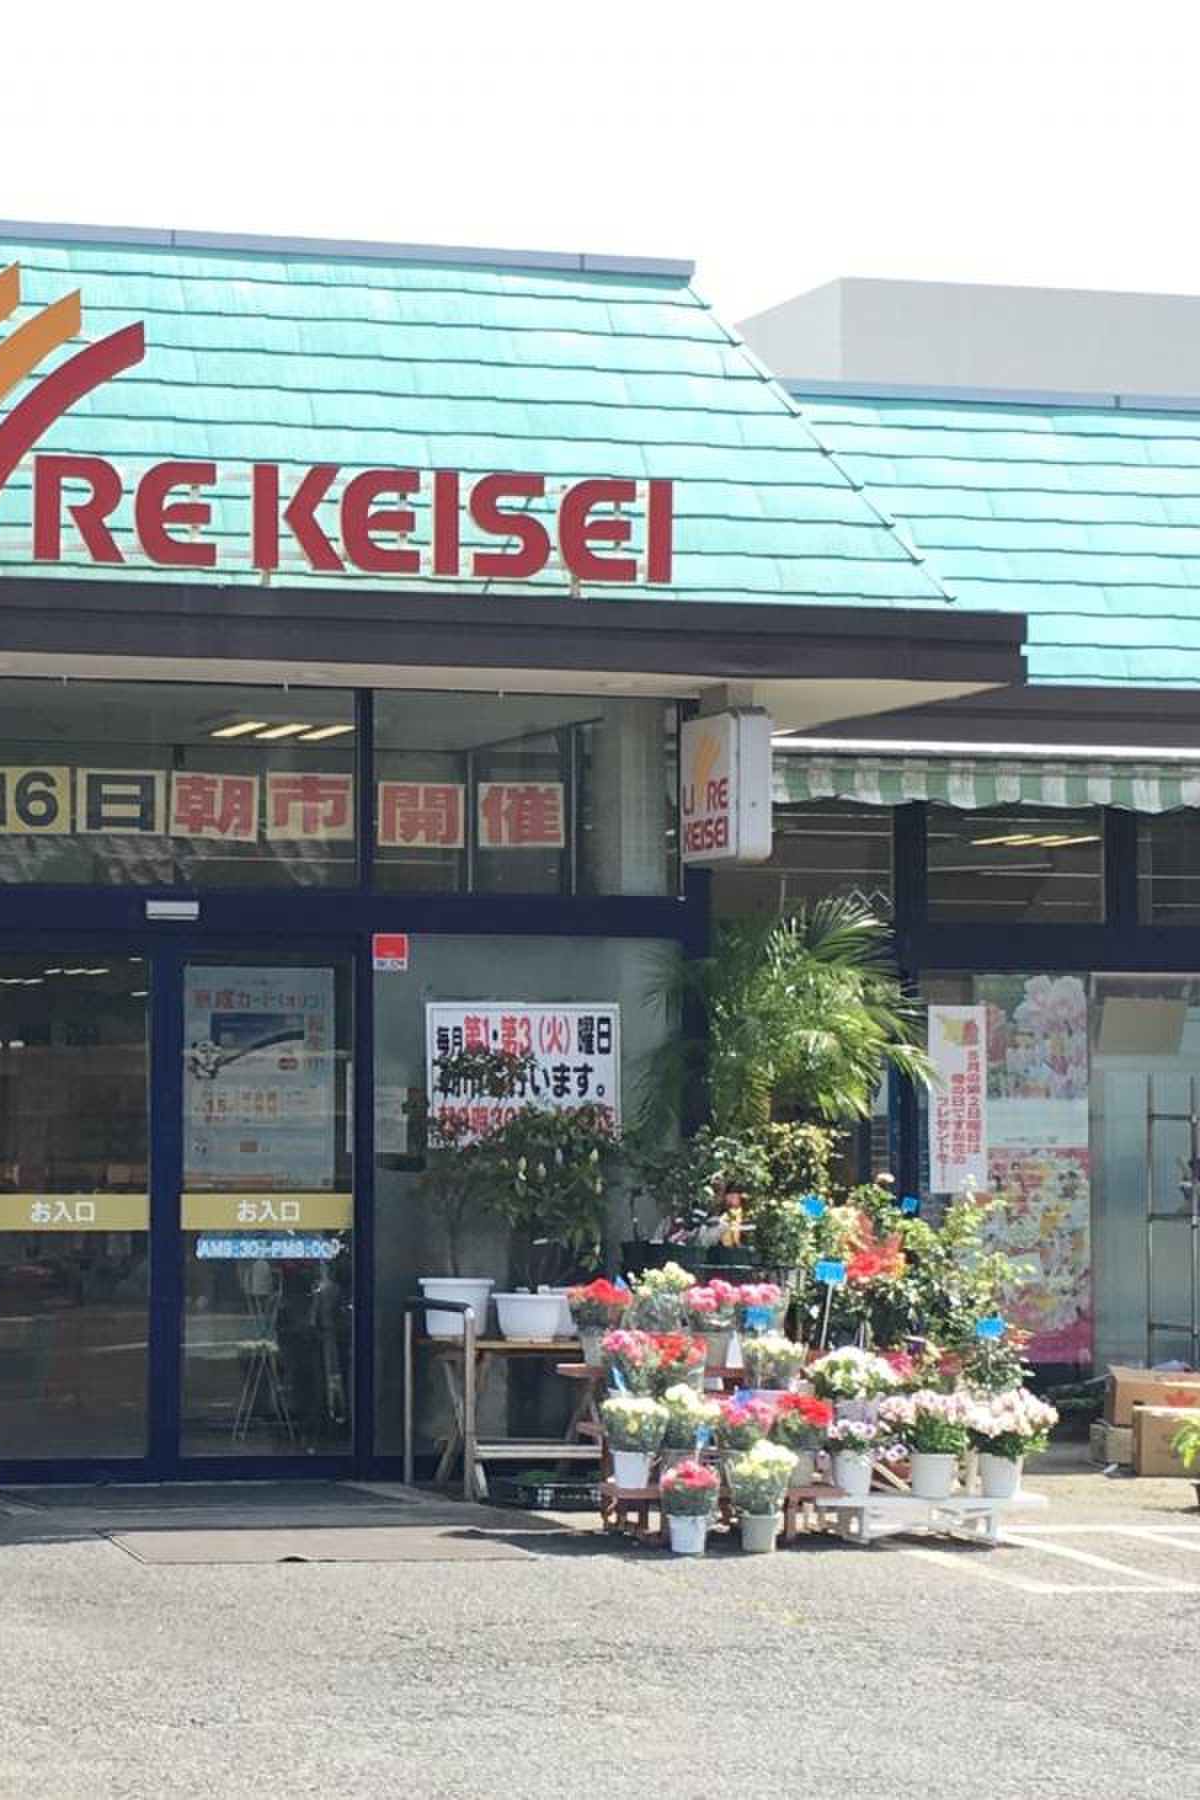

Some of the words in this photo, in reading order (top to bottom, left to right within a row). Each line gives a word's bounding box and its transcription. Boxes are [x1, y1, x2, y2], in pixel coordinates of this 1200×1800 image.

[251, 463, 674, 583] KEISEI
[29, 1200, 96, 1223] お入口
[237, 1200, 300, 1223] お入口
